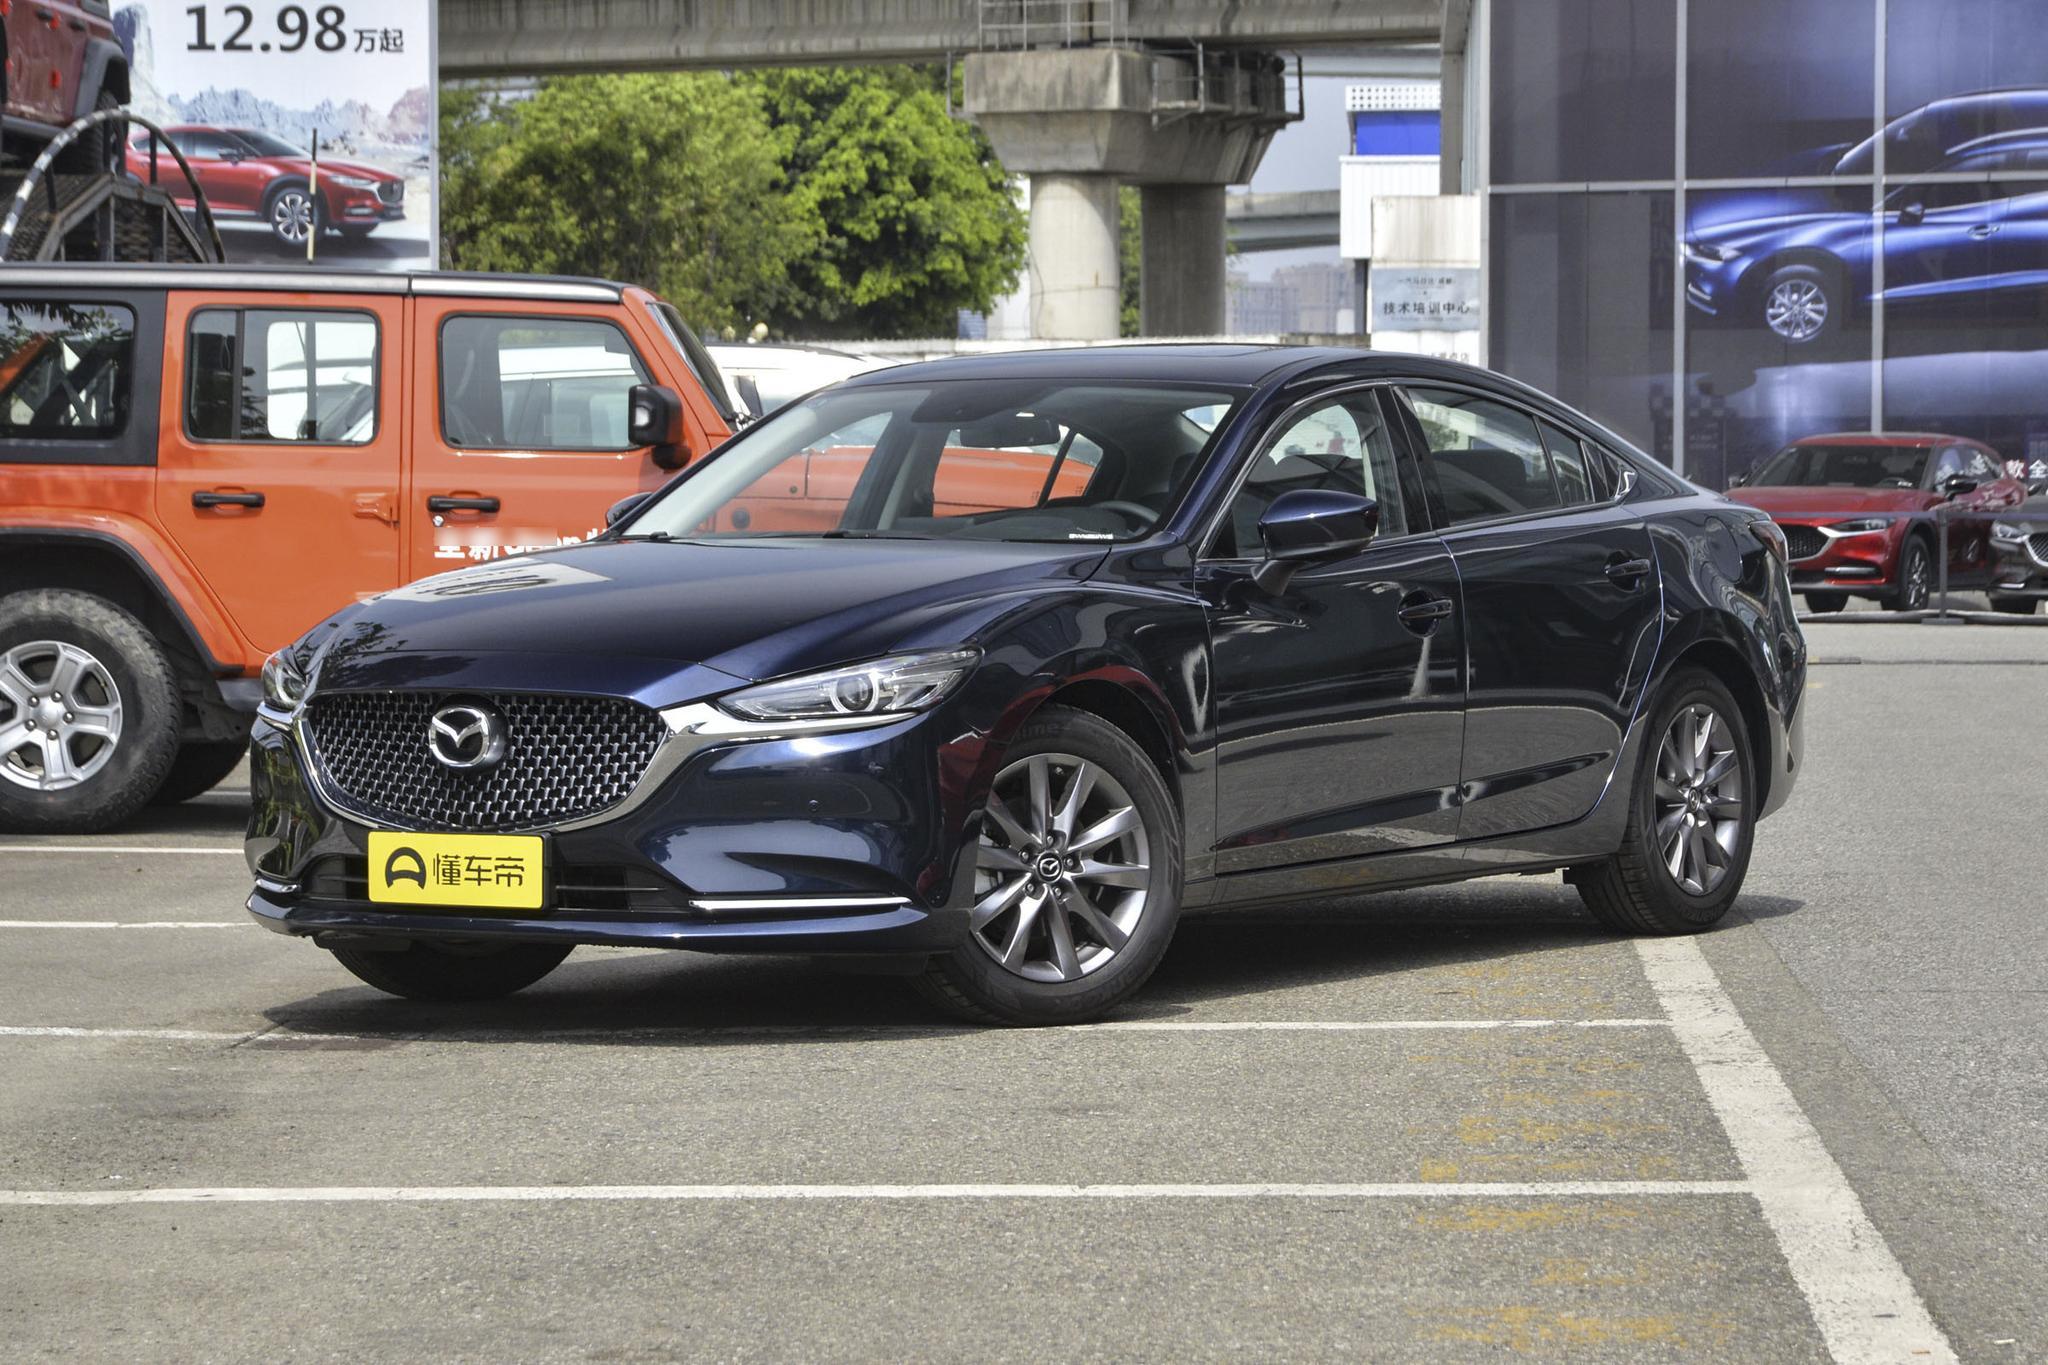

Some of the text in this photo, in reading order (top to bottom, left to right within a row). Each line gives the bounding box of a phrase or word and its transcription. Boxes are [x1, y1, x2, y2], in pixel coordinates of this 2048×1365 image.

[185, 4, 405, 54] 12.98 万起
[1383, 301, 1470, 315] 技术培训中心
[432, 853, 525, 888] 懂车帝
